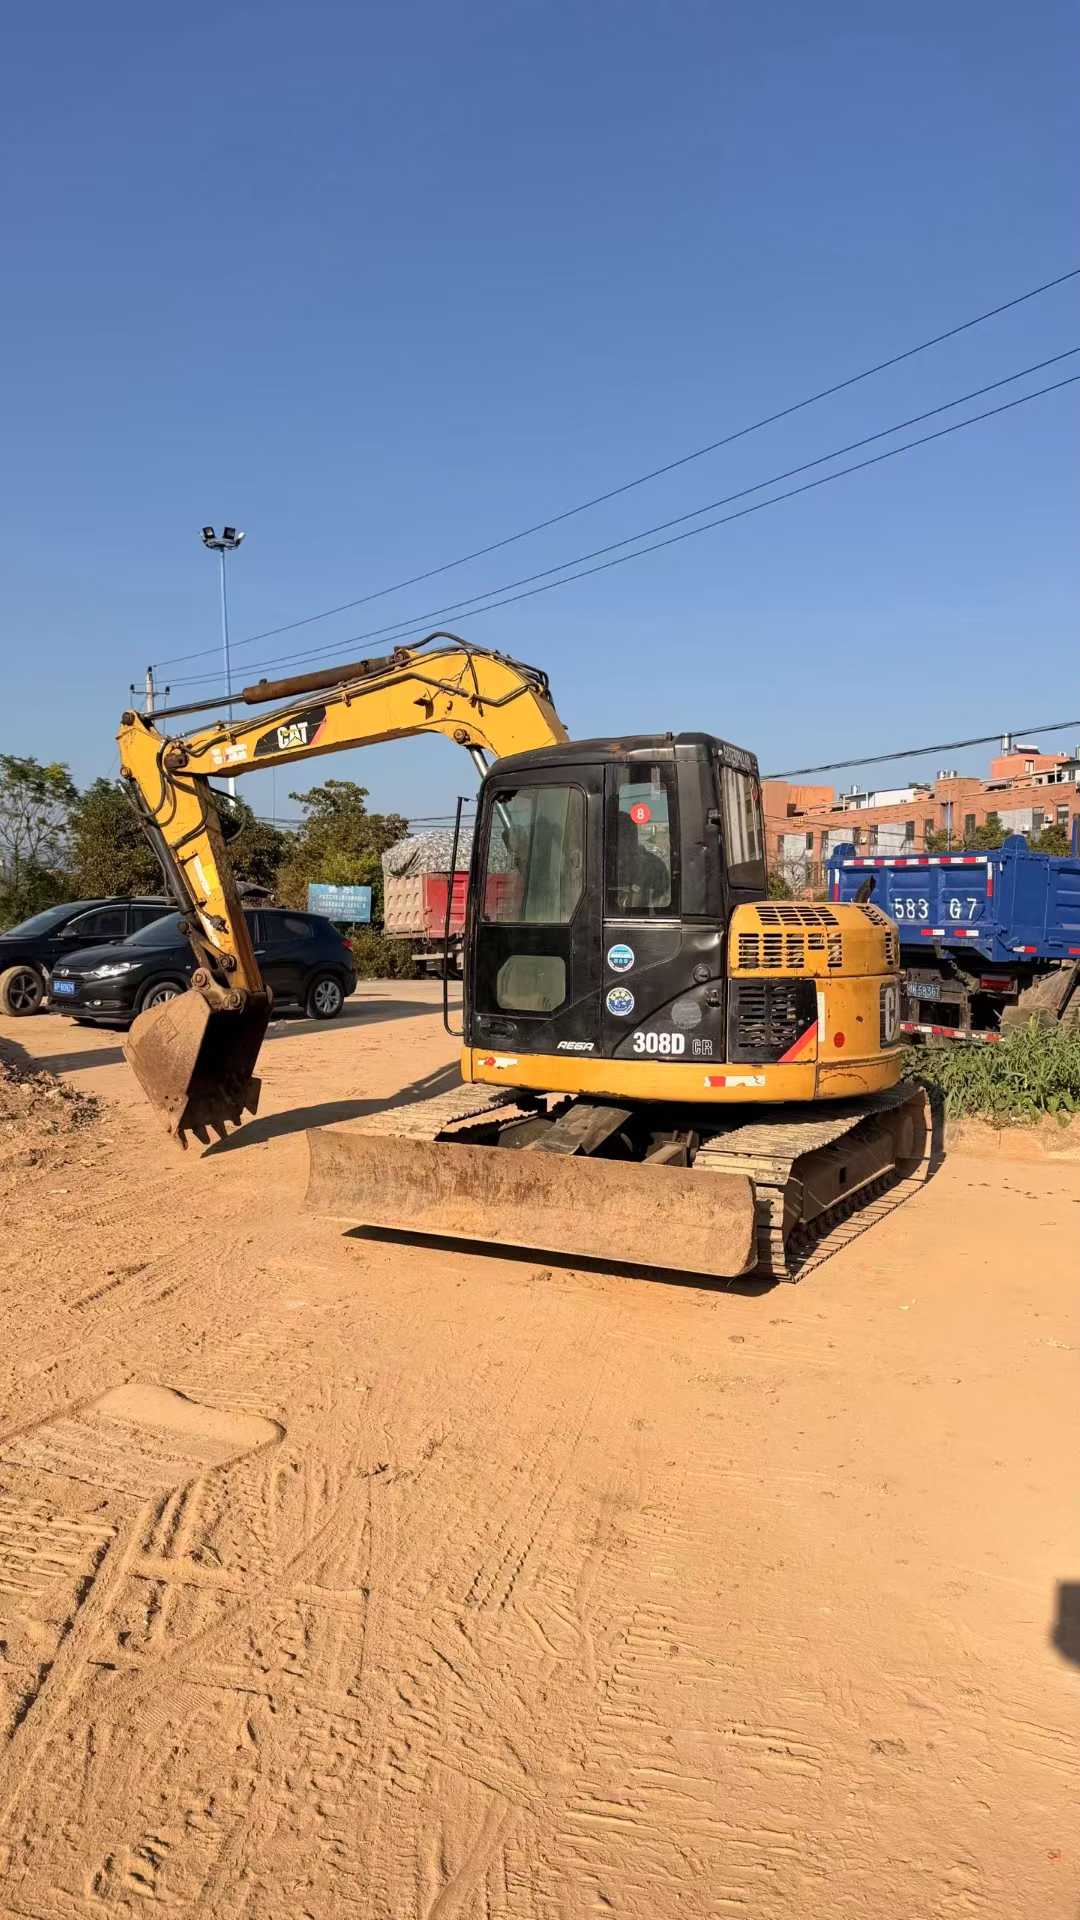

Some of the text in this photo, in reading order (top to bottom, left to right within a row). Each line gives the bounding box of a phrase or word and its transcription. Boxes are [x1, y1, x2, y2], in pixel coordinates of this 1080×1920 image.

[277, 722, 308, 749] CAT
[894, 898, 929, 919] 583
[633, 1032, 712, 1055] 308D CR
